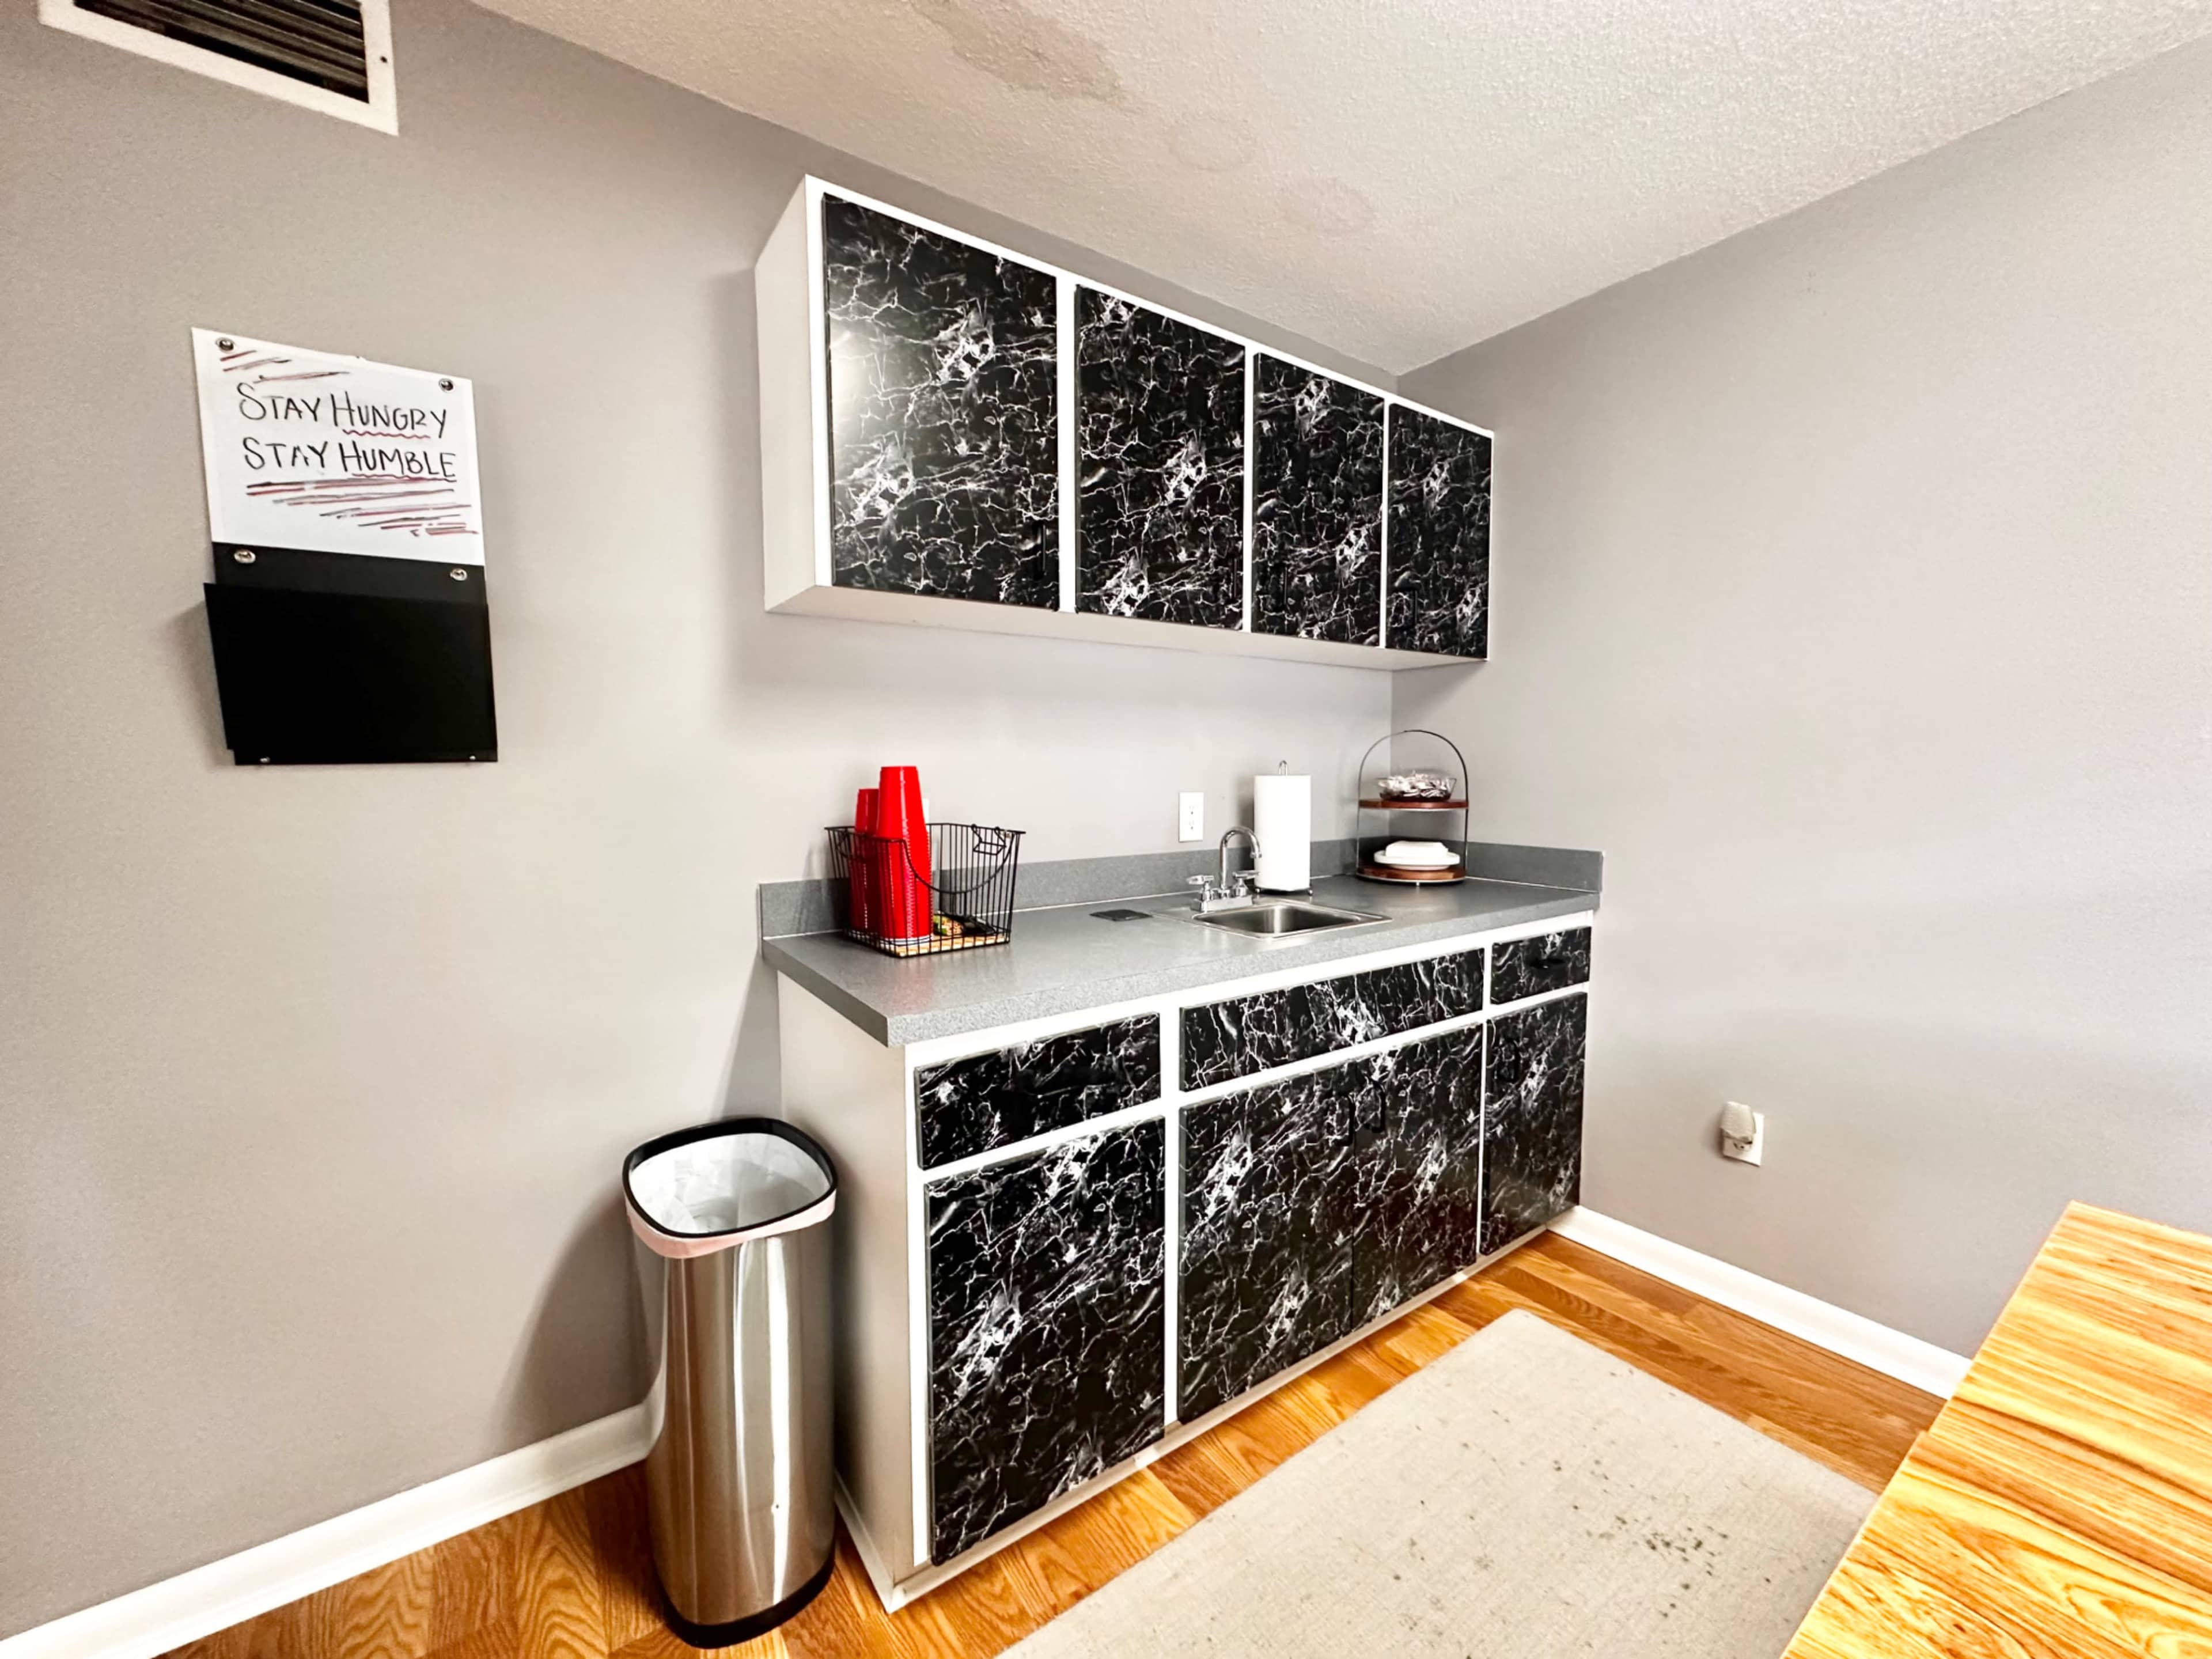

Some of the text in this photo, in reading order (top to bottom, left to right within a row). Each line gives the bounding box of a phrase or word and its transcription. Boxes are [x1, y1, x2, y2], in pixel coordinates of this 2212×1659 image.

[237, 382, 446, 438] STAY HUNGRY
[243, 437, 457, 478] STAY HUMBLE
